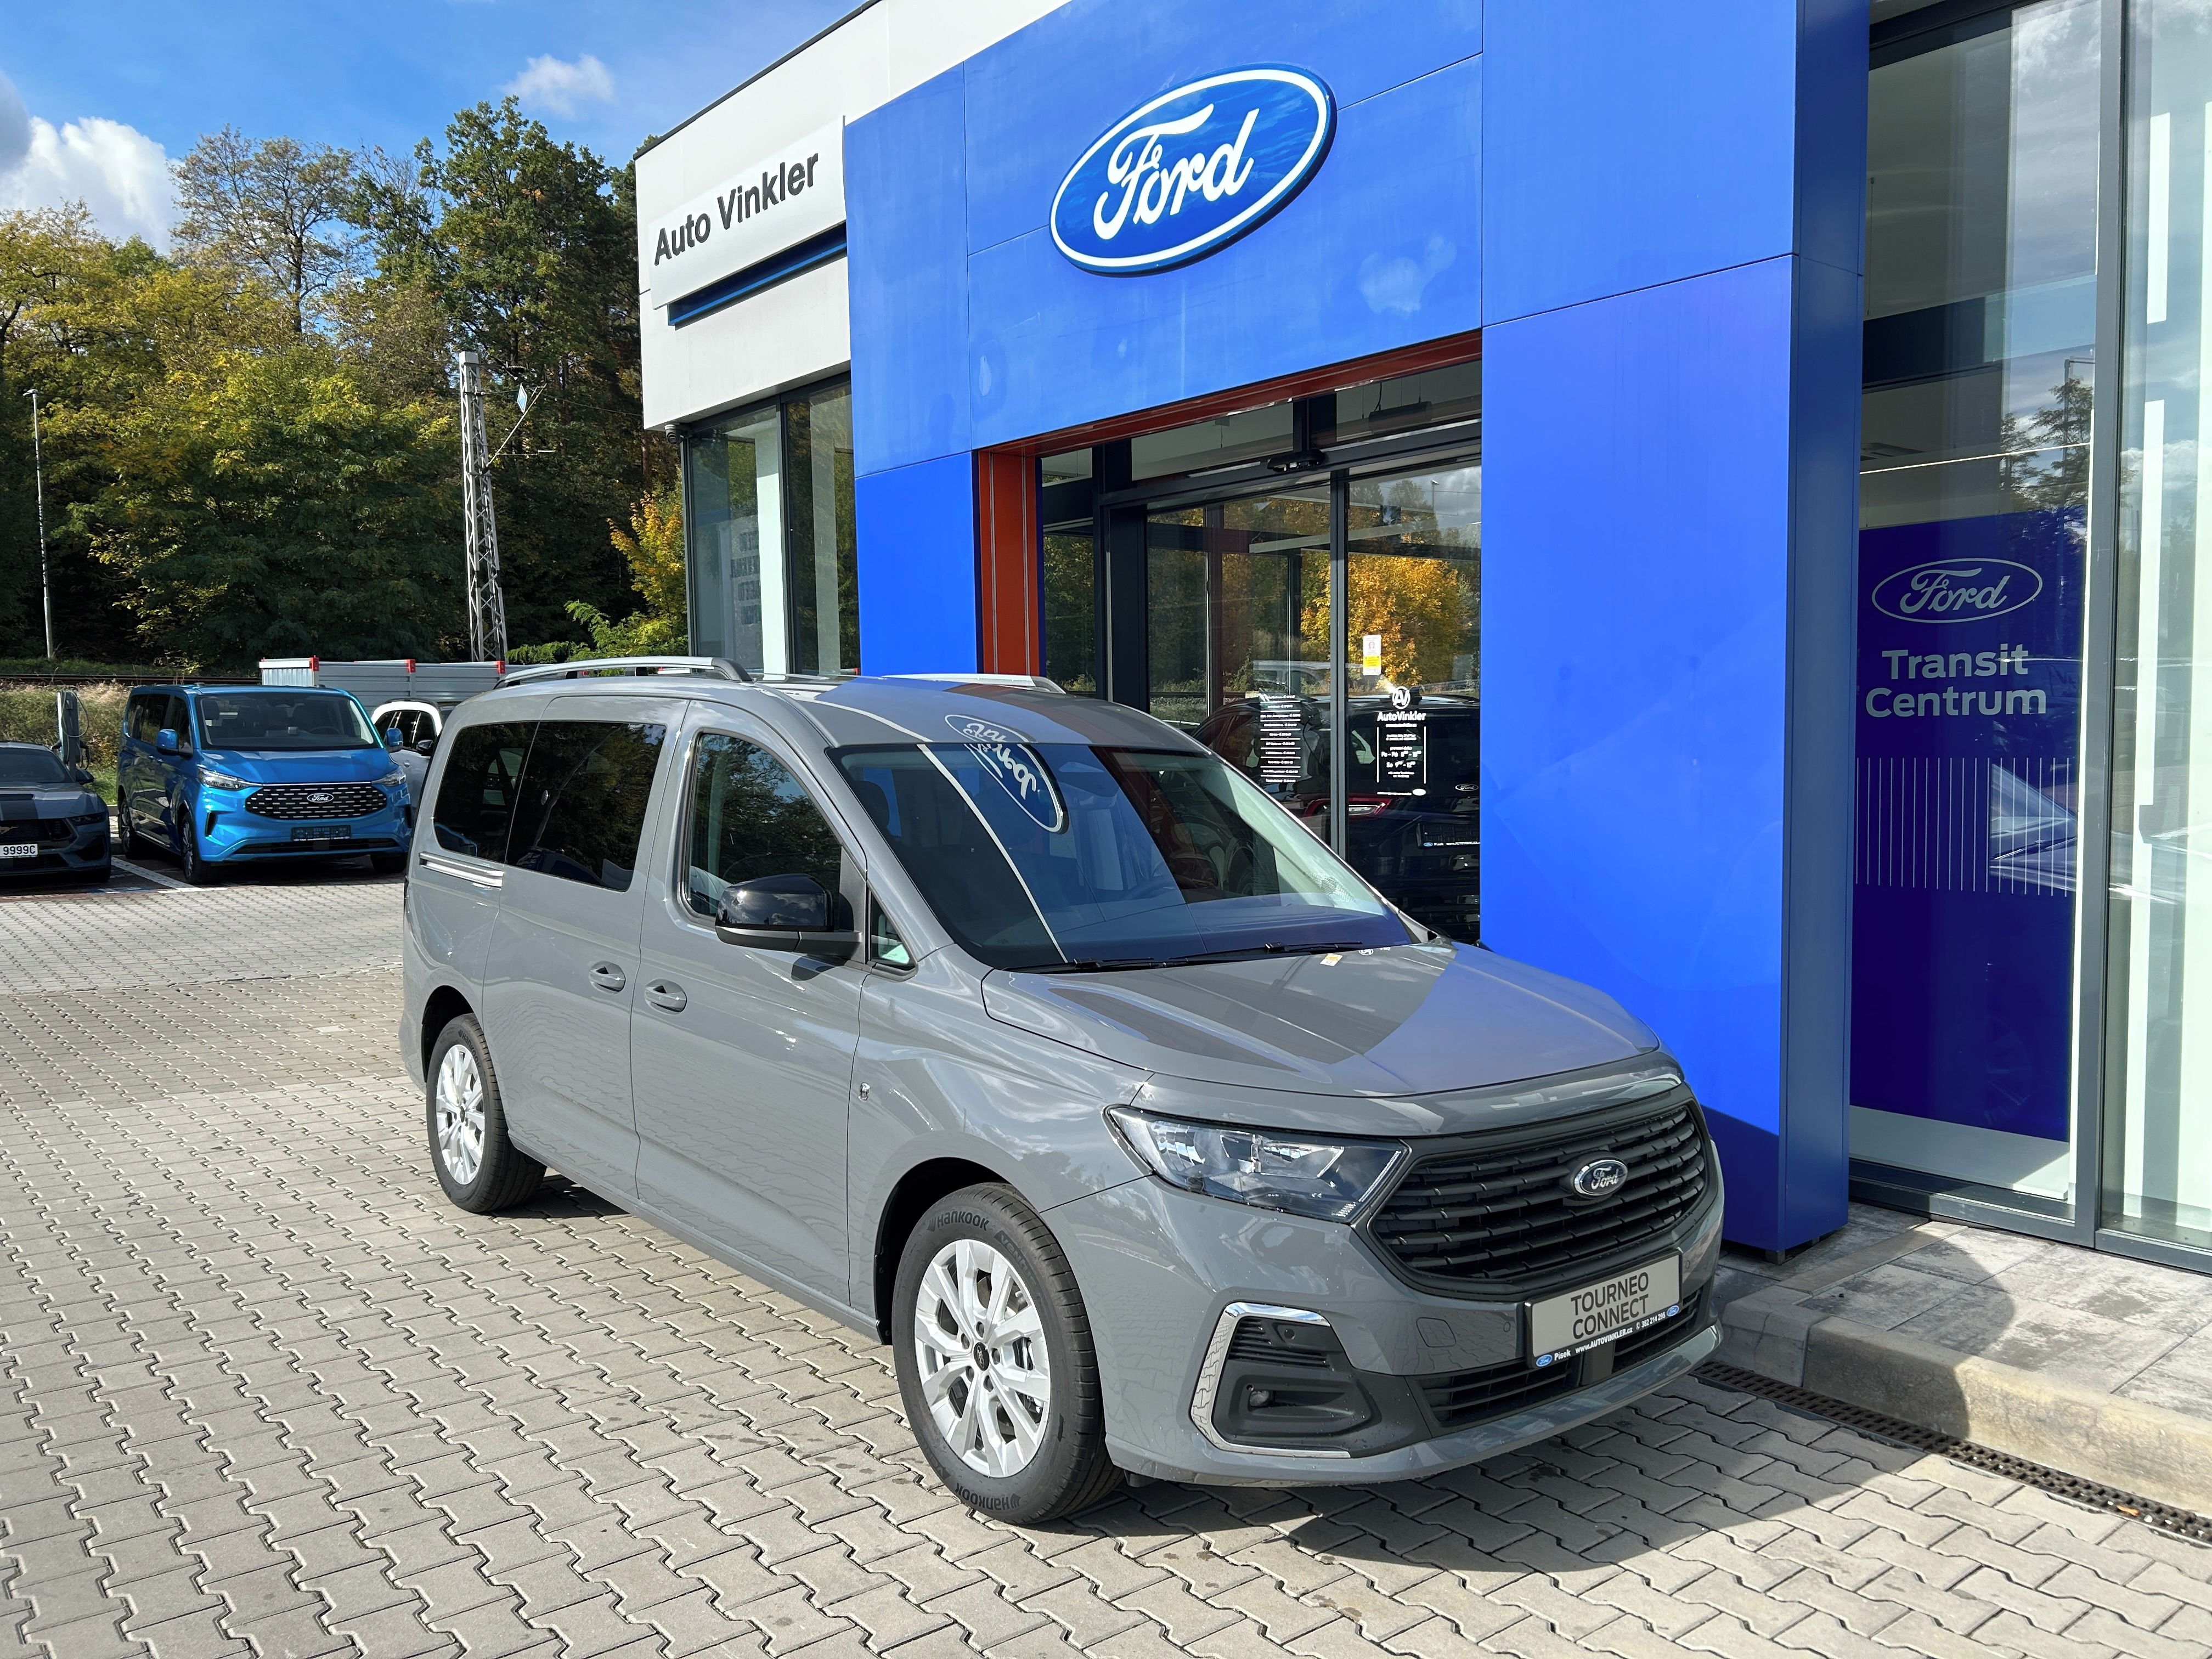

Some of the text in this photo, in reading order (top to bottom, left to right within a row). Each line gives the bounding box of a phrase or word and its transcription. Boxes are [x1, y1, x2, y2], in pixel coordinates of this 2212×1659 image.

[1093, 103, 1260, 240] Ford
[654, 153, 819, 266] Auto Vinkler
[1899, 567, 2011, 613] Ford
[1882, 643, 2029, 680] Transit
[1376, 710, 1426, 721] AutoVinkler
[1865, 686, 2047, 718] Centrum
[3, 845, 36, 855] 9999C
[1591, 1166, 1619, 1189] Ford
[1571, 1272, 1649, 1316] TOURNEO
[1572, 1294, 1649, 1340] CONNECT
